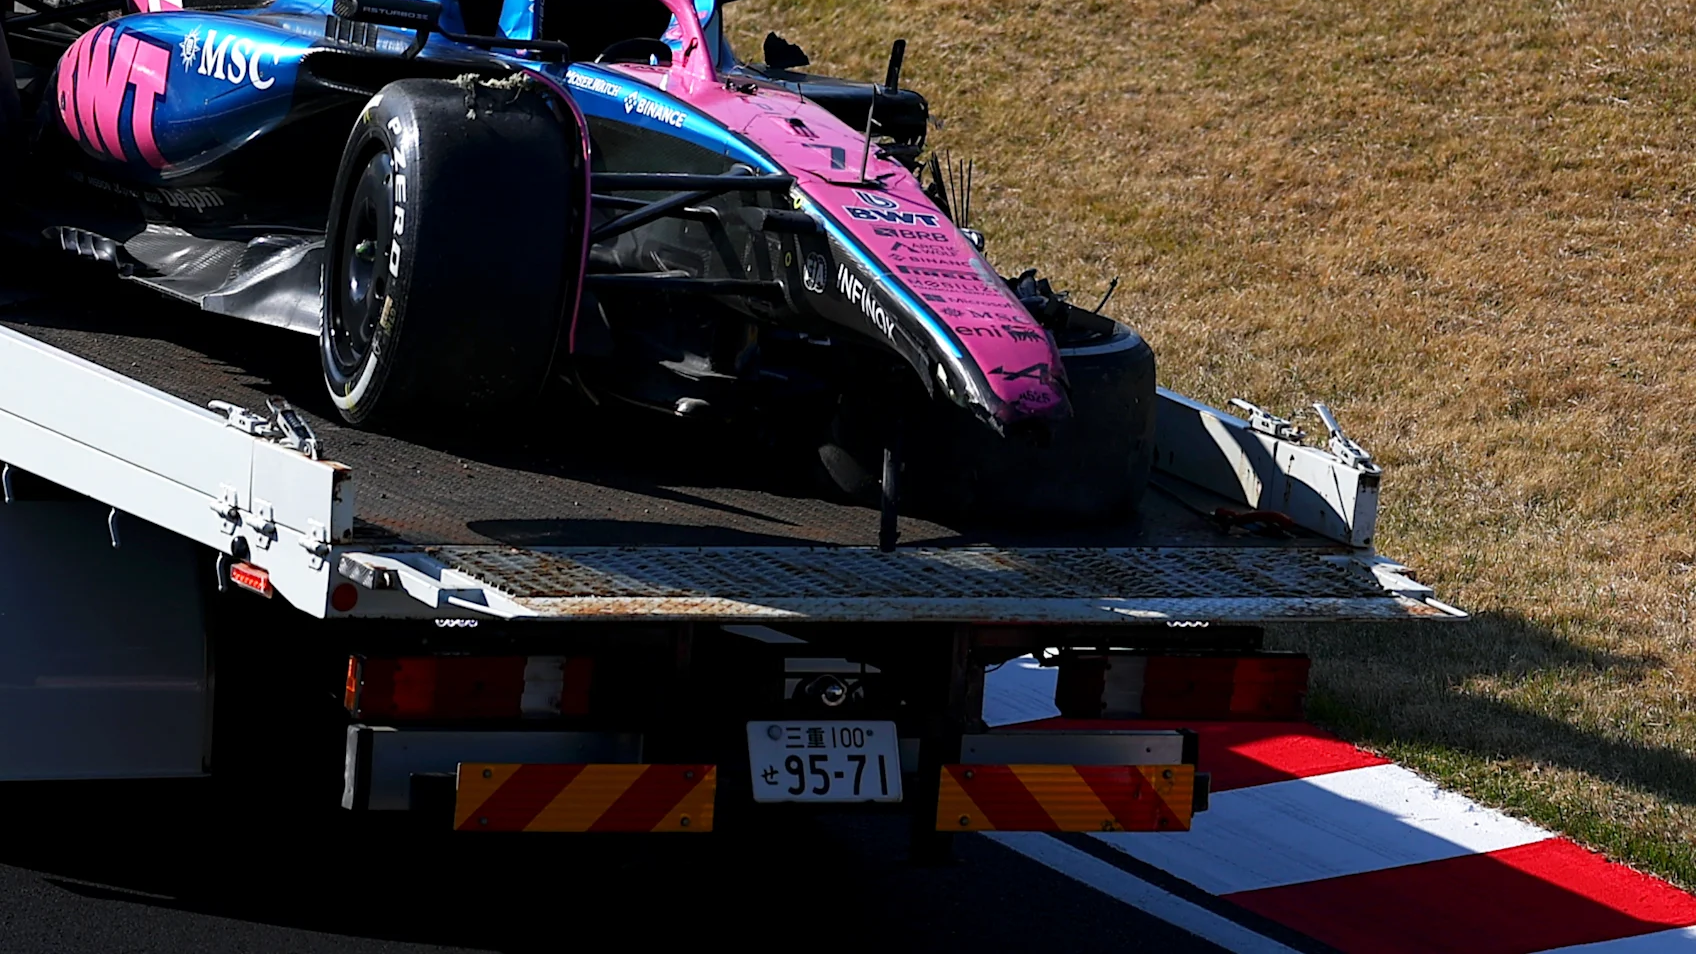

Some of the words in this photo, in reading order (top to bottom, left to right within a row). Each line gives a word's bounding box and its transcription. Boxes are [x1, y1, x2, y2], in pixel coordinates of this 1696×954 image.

[198, 29, 279, 90] MSC
[636, 98, 687, 128] BINANCE
[157, 186, 225, 214] Delphi
[388, 147, 407, 278] ZERO
[842, 205, 940, 228] BWT
[899, 229, 949, 243] BRB
[909, 256, 972, 268] BINANC
[966, 309, 1032, 324] MSC
[955, 324, 1003, 338] eni
[761, 764, 779, 785] せ
[784, 754, 888, 795] 95-71
